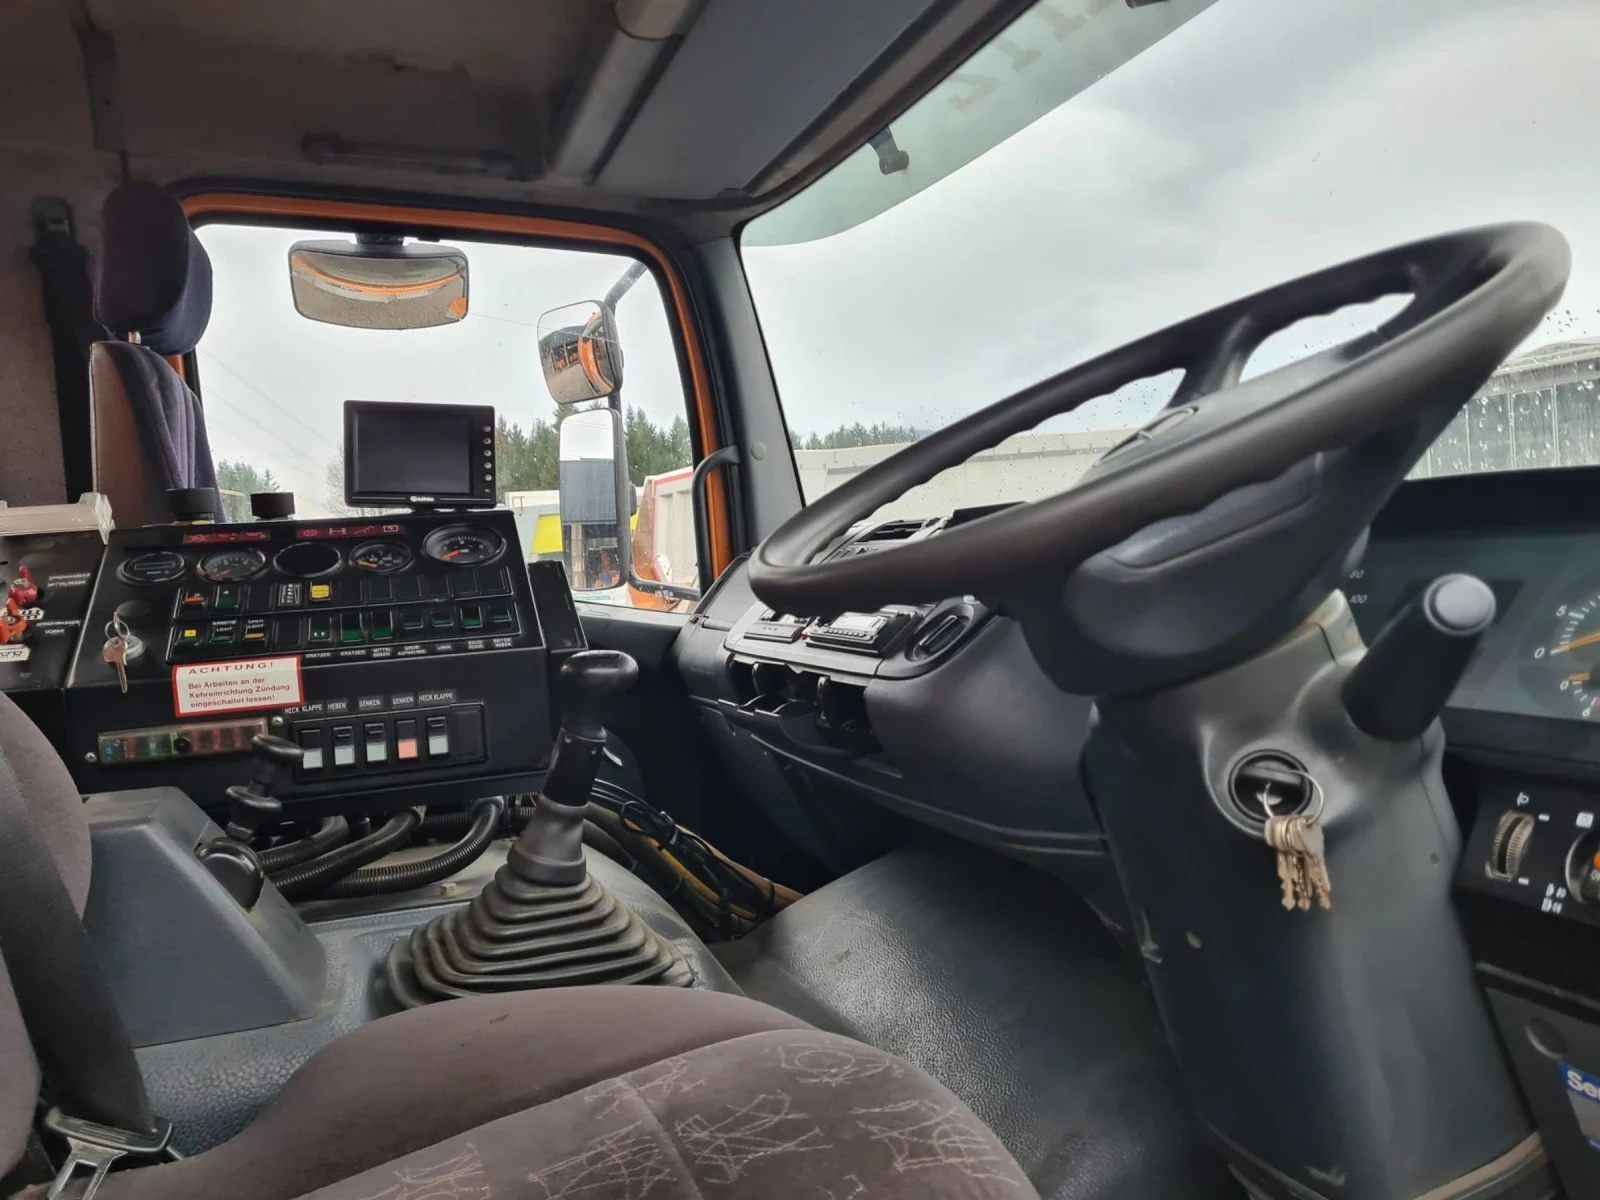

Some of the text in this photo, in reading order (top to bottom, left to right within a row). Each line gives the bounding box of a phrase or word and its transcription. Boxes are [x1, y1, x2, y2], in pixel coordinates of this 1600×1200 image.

[1349, 594, 1368, 604] 100
[1556, 604, 1567, 617] 5
[1534, 647, 1545, 659] 0
[188, 662, 273, 675] ACHTUNG!
[204, 680, 238, 689] Arbeiten
[1560, 680, 1569, 690] 0
[189, 684, 290, 699] Kehreinrichtung Zündung
[191, 694, 275, 708] eingeschaltet lassen!
[392, 696, 414, 705] SENKEN
[418, 692, 453, 702] HECK KLAPPE
[327, 701, 346, 710] HEBEN
[358, 699, 380, 708] SENKEN
[284, 704, 323, 715] HECK KLAPPE
[1567, 1069, 1600, 1101] Se
